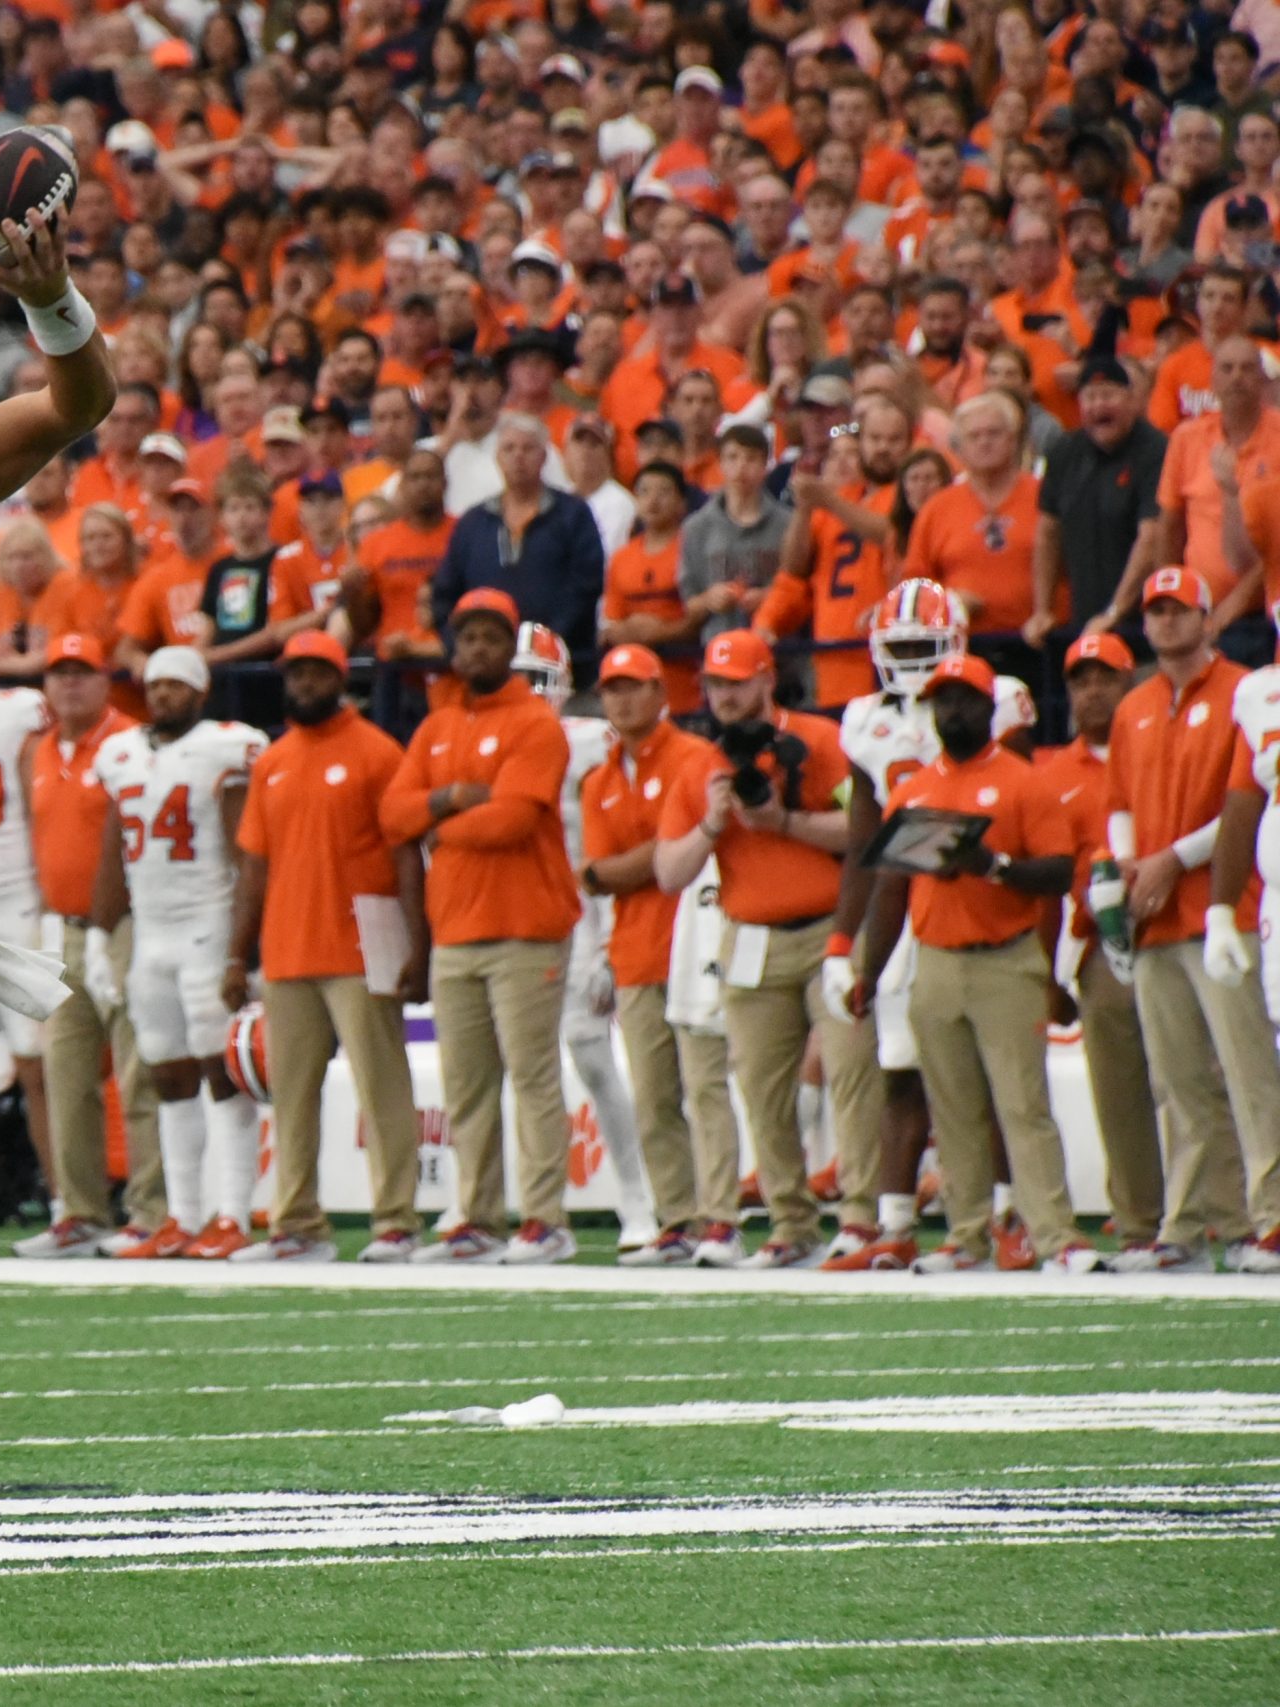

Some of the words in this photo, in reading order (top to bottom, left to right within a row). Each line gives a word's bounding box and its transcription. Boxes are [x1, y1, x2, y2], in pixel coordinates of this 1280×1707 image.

[831, 532, 862, 598] 2
[712, 640, 732, 664] C
[118, 784, 195, 862] 54
